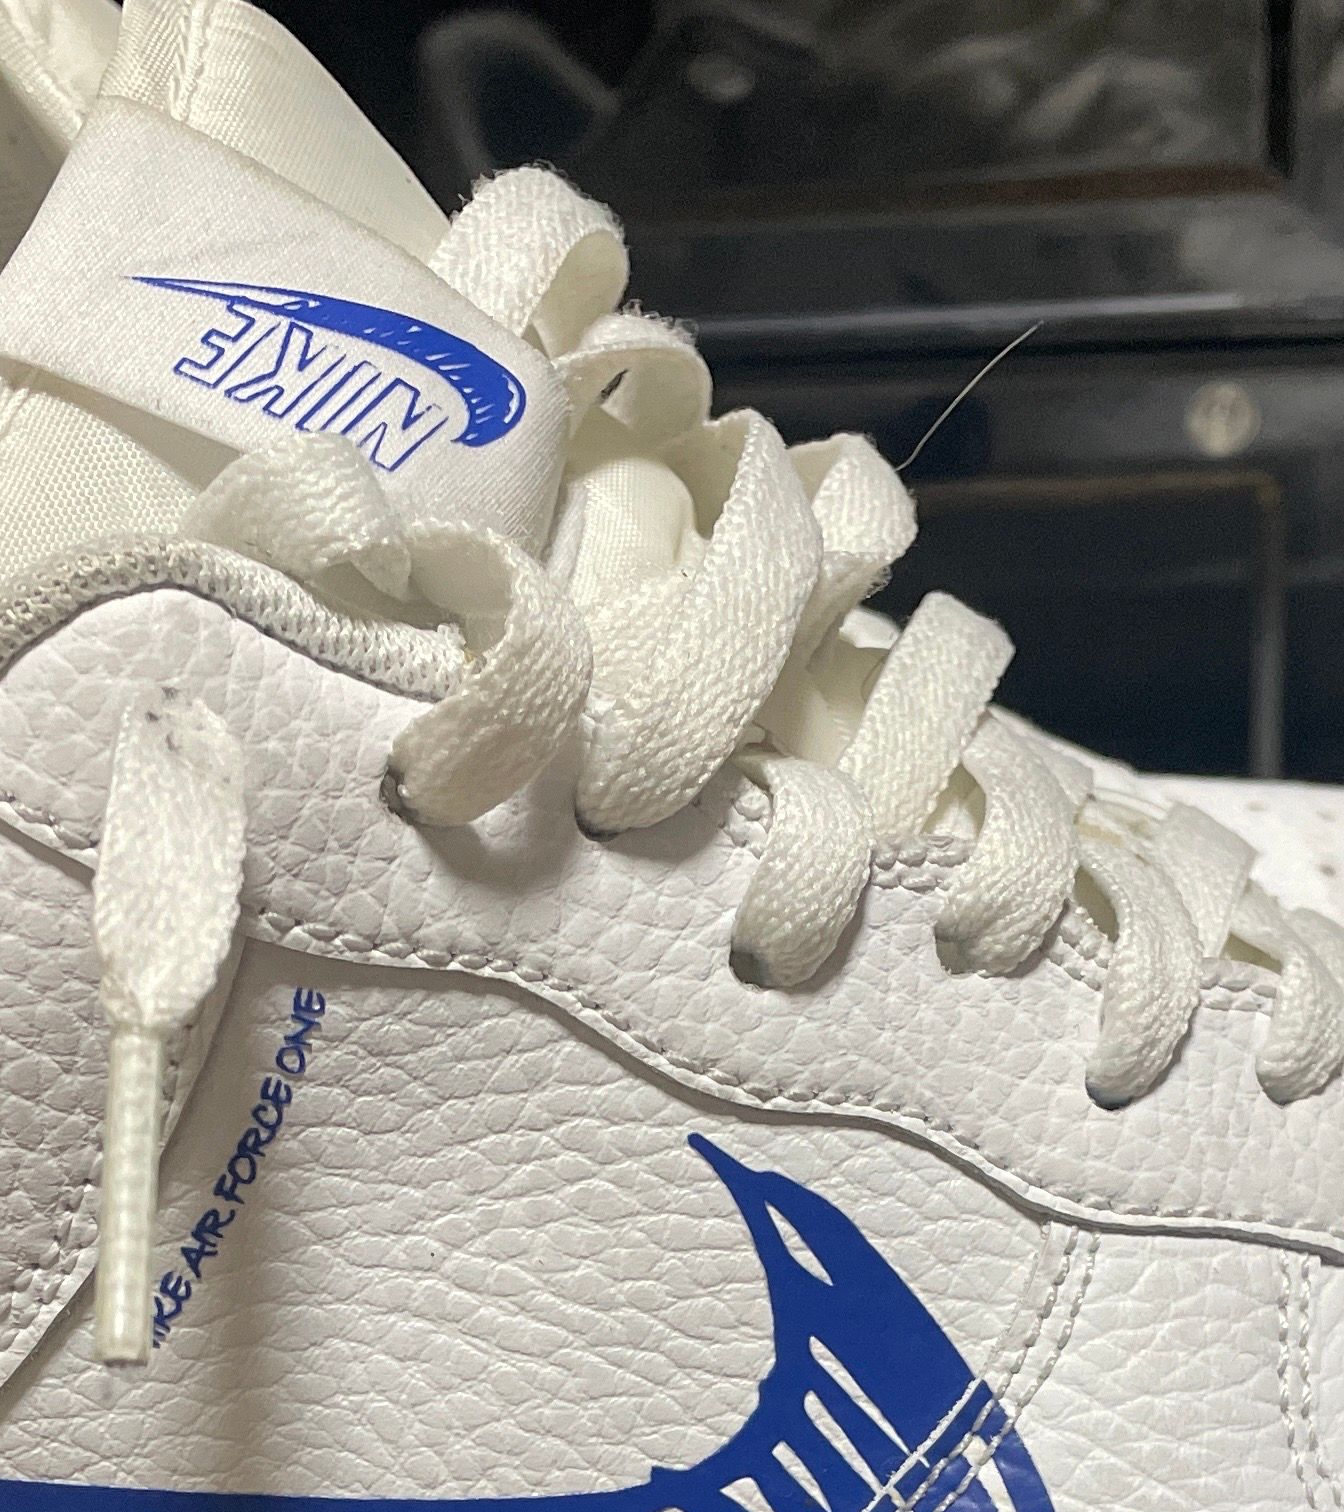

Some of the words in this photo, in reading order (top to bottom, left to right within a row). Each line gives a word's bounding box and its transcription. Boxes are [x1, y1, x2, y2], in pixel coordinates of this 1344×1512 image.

[173, 298, 449, 472] NIKE
[181, 1208, 236, 1279] AIR
[214, 1076, 292, 1205] FORCE
[275, 986, 326, 1075] ONE
